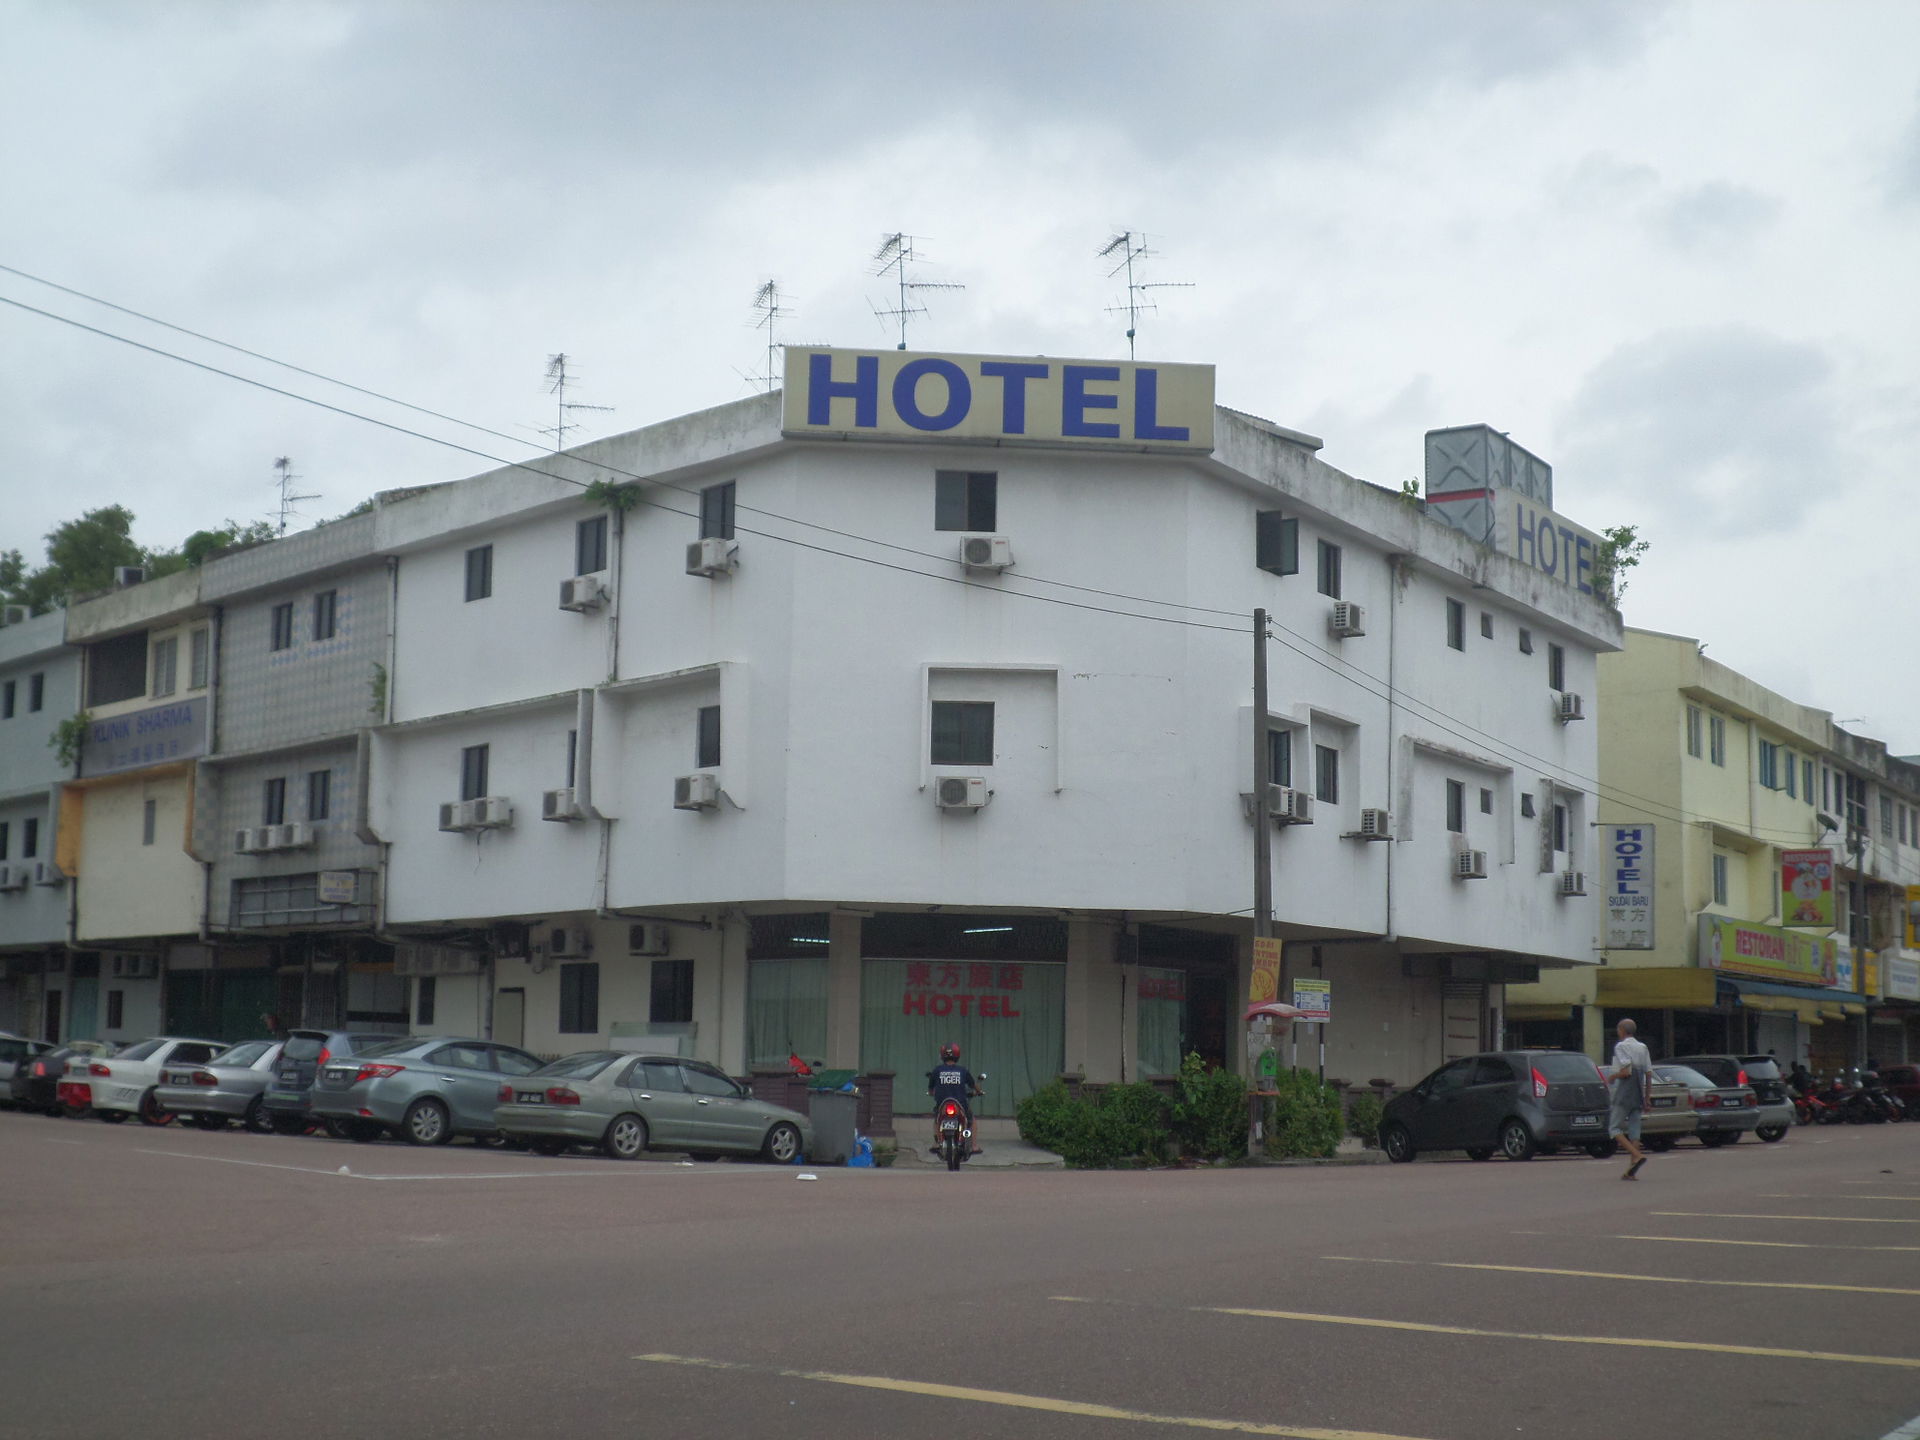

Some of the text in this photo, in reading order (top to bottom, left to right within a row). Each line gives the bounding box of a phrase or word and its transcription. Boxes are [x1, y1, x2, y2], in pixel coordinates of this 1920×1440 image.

[807, 353, 1190, 441] HOTEL
[1517, 503, 1608, 603] HOTEL
[94, 704, 192, 743] KLINIK SHARMA
[1615, 829, 1643, 894] HOTEL
[1608, 896, 1649, 906] SKUDAI BARU
[1735, 928, 1784, 960] RESTORAN
[902, 992, 1021, 1017] HOTEL
[939, 1076, 961, 1085] TIGER
